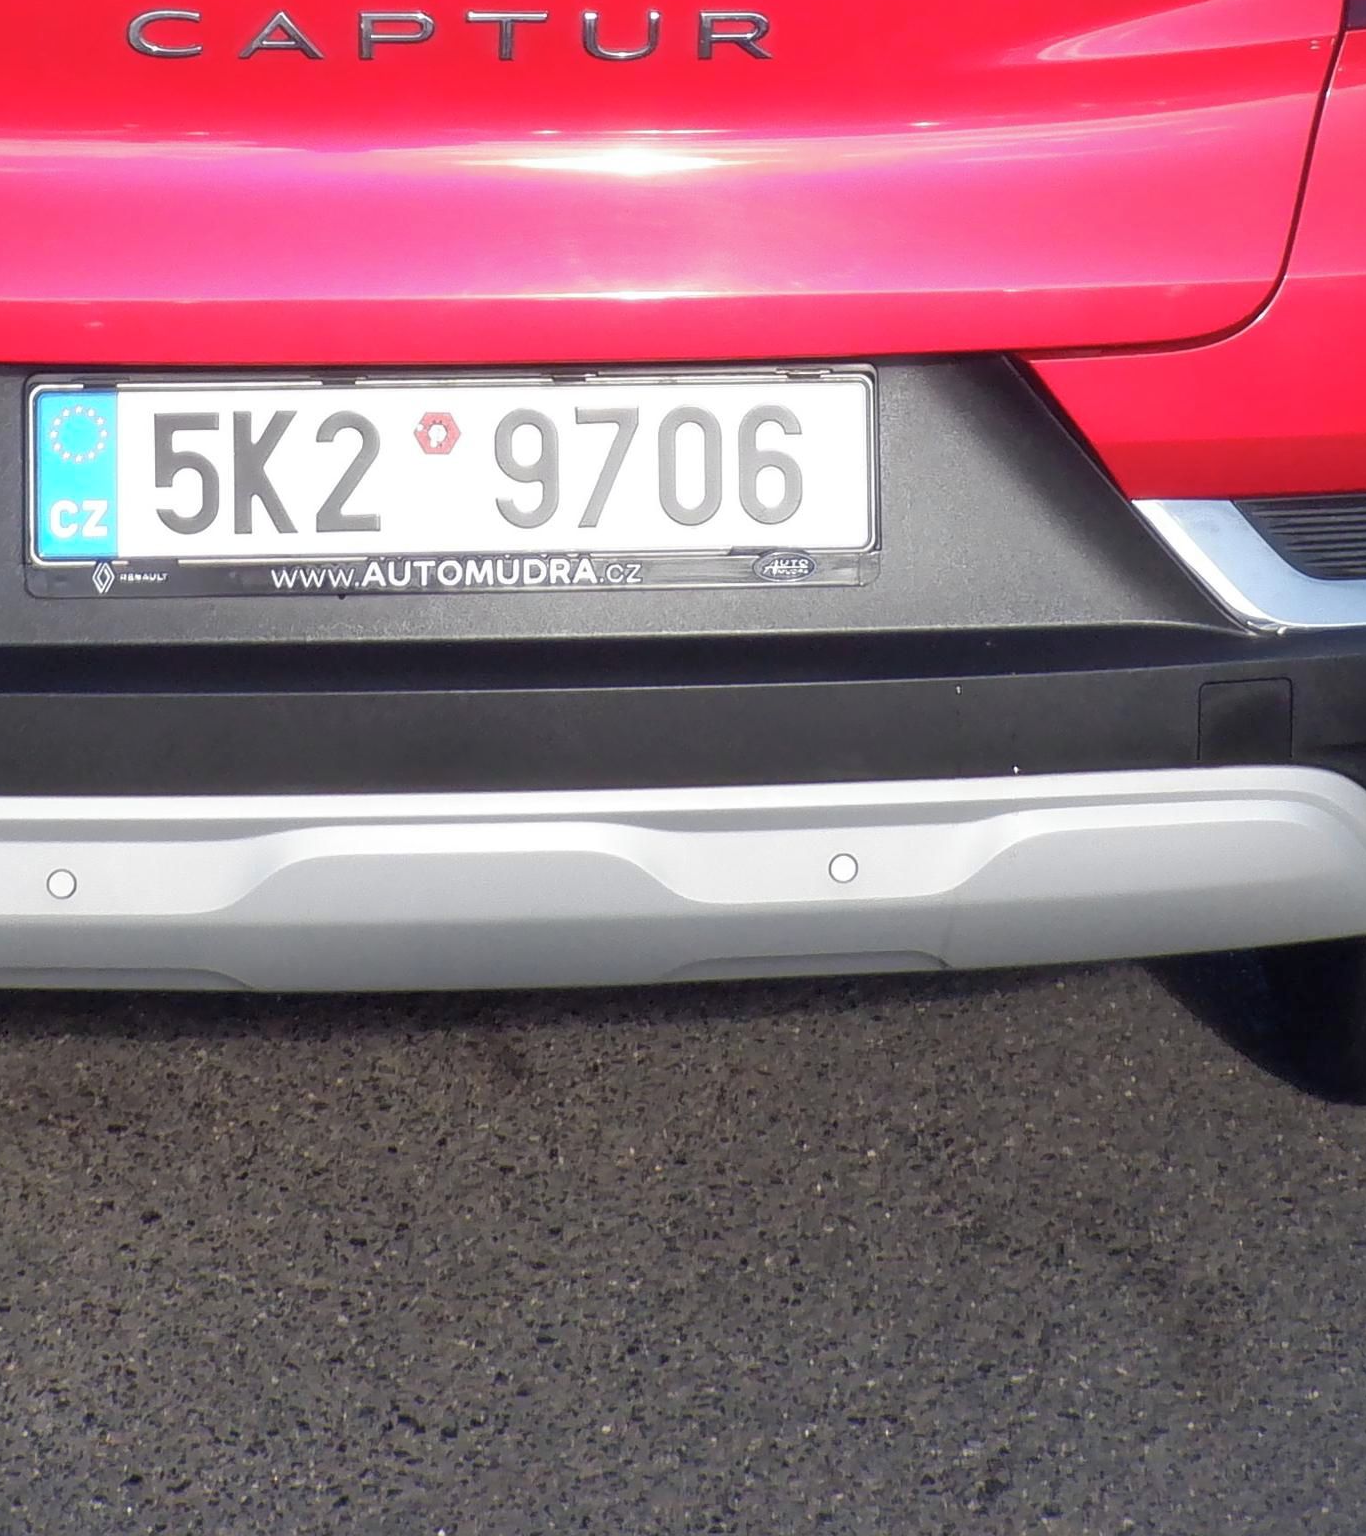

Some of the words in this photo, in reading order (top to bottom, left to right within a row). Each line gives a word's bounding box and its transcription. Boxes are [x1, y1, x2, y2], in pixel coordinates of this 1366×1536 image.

[125, 9, 773, 61] CAPTUR
[152, 409, 383, 536] 5K2
[493, 405, 805, 530] 9706
[49, 499, 110, 540] CZ
